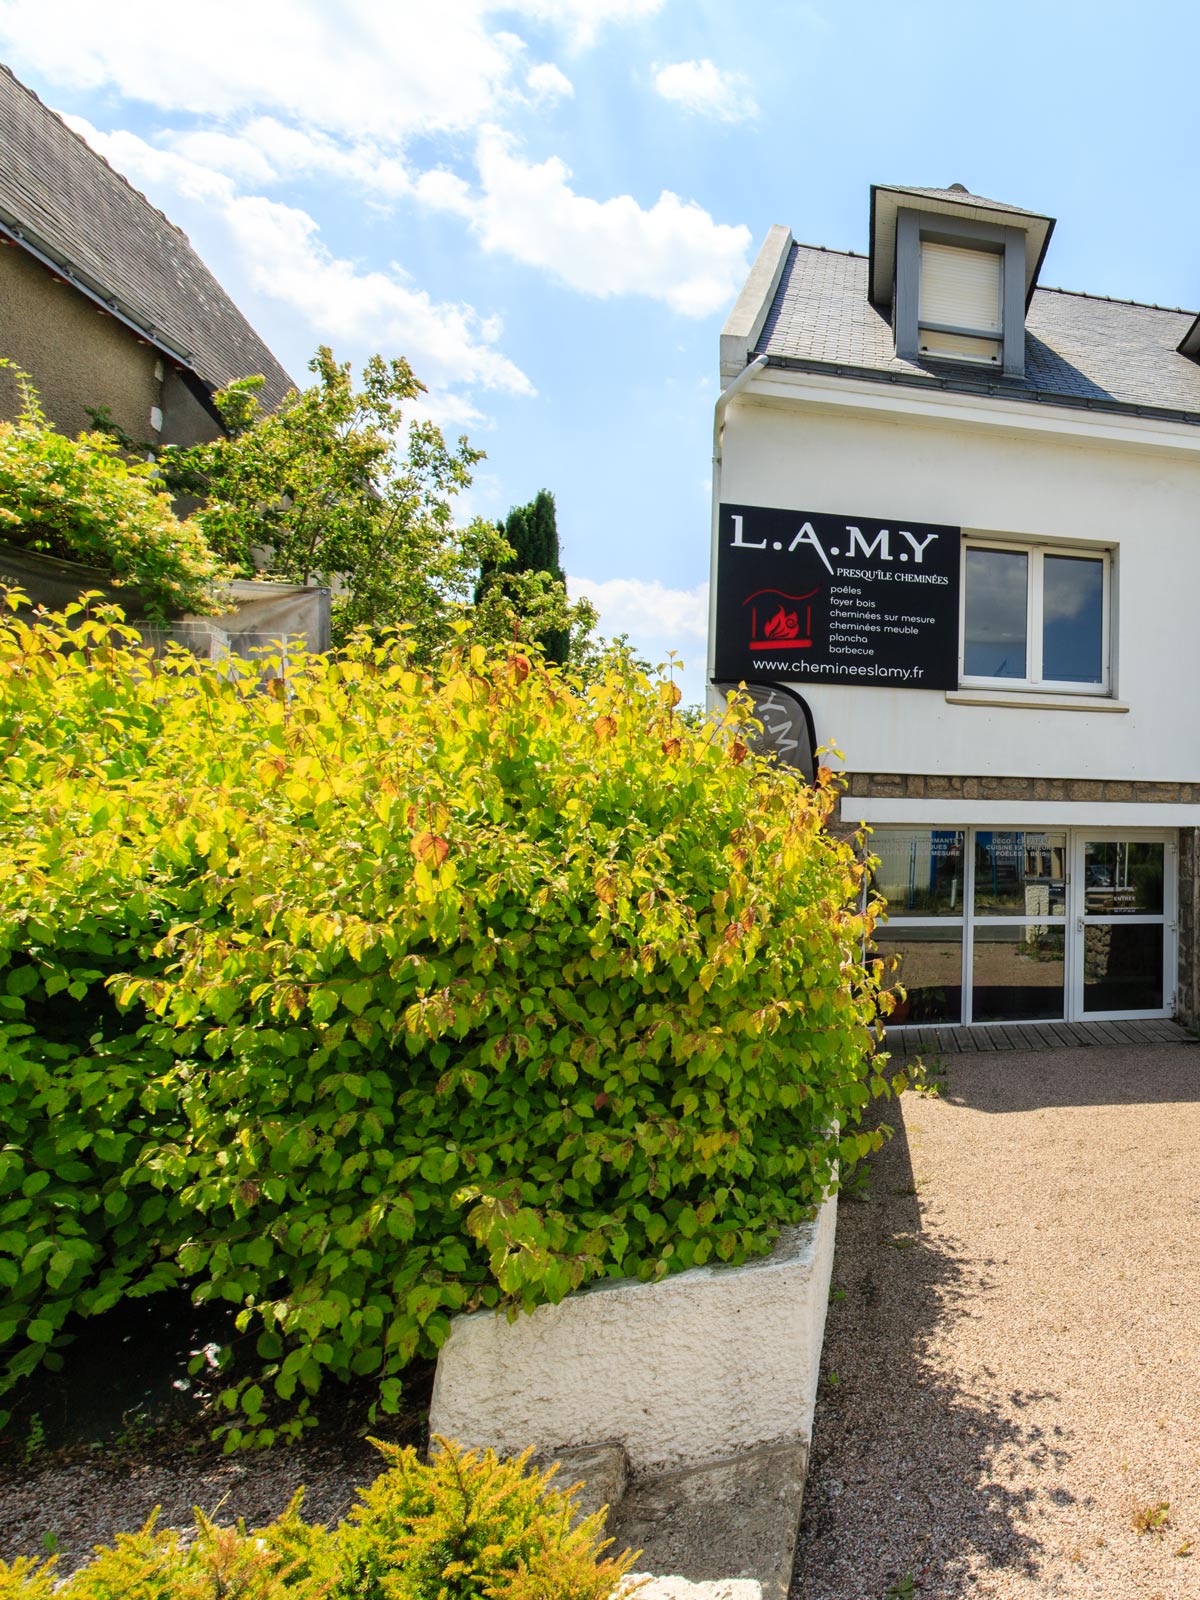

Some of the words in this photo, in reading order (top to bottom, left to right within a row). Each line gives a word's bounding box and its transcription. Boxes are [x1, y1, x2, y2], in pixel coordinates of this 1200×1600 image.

[730, 514, 939, 576] L.A.M.Y
[836, 567, 893, 581] PRESQU'ÎLE
[894, 572, 949, 585] CHEMINÉES
[830, 585, 862, 595] poêles
[830, 596, 854, 607] foyer
[856, 598, 876, 608] bois
[829, 609, 881, 621] cheminées
[884, 614, 899, 622] sur
[901, 615, 936, 624] mesure
[829, 620, 881, 632] cheminées
[883, 626, 919, 635] meuble
[829, 633, 868, 643] plancha
[829, 644, 875, 656] barbecue
[753, 659, 925, 681] www.chemineeslamy.fr
